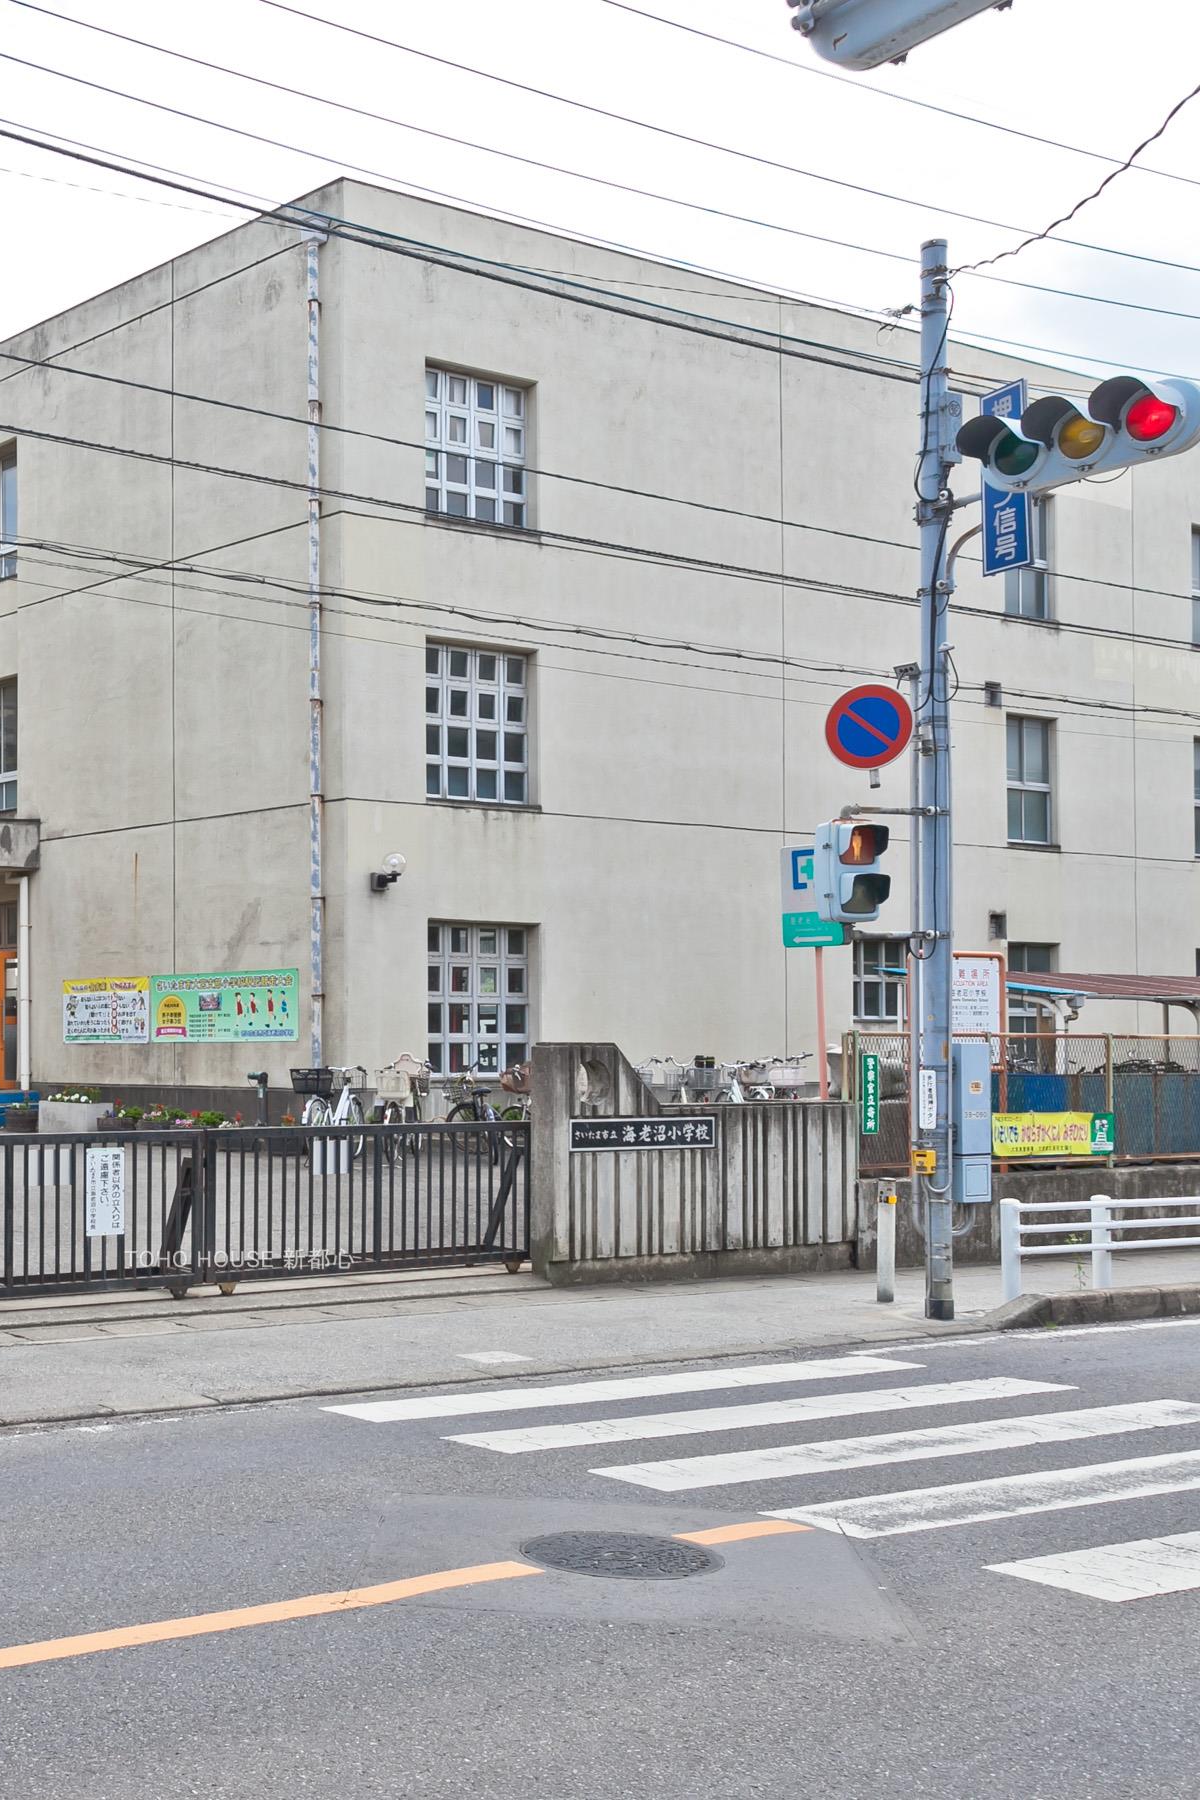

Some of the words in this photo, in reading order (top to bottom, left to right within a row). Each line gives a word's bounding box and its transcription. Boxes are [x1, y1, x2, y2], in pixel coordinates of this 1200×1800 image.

[957, 968, 990, 979] 難場所
[574, 1129, 618, 1140] さいたま市立
[622, 1123, 711, 1143] 海老沼小学校
[111, 1153, 121, 1229] 関係者以外の立入りは
